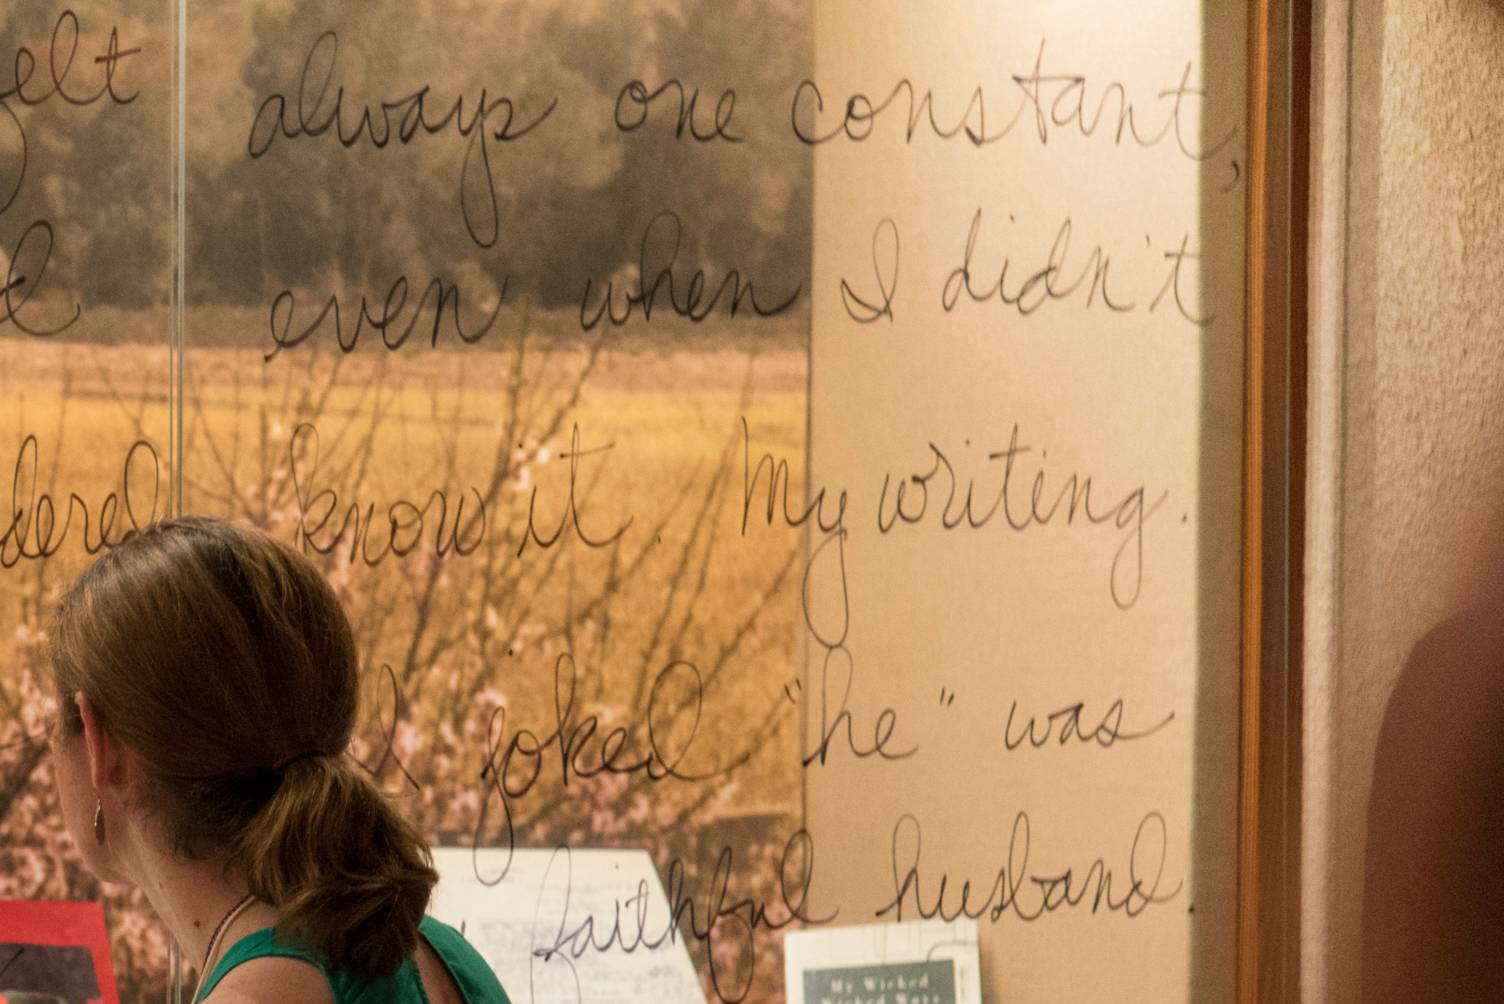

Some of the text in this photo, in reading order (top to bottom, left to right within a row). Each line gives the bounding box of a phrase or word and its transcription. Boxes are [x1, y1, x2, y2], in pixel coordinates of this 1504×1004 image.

[248, 30, 1241, 249] always one constant,
[263, 207, 1216, 362] even when I didn't
[290, 422, 490, 567] know
[741, 415, 850, 649] My
[876, 421, 1190, 611] writing.
[473, 650, 752, 886] joked
[1004, 697, 1177, 752] was
[874, 812, 1196, 926] husband.
